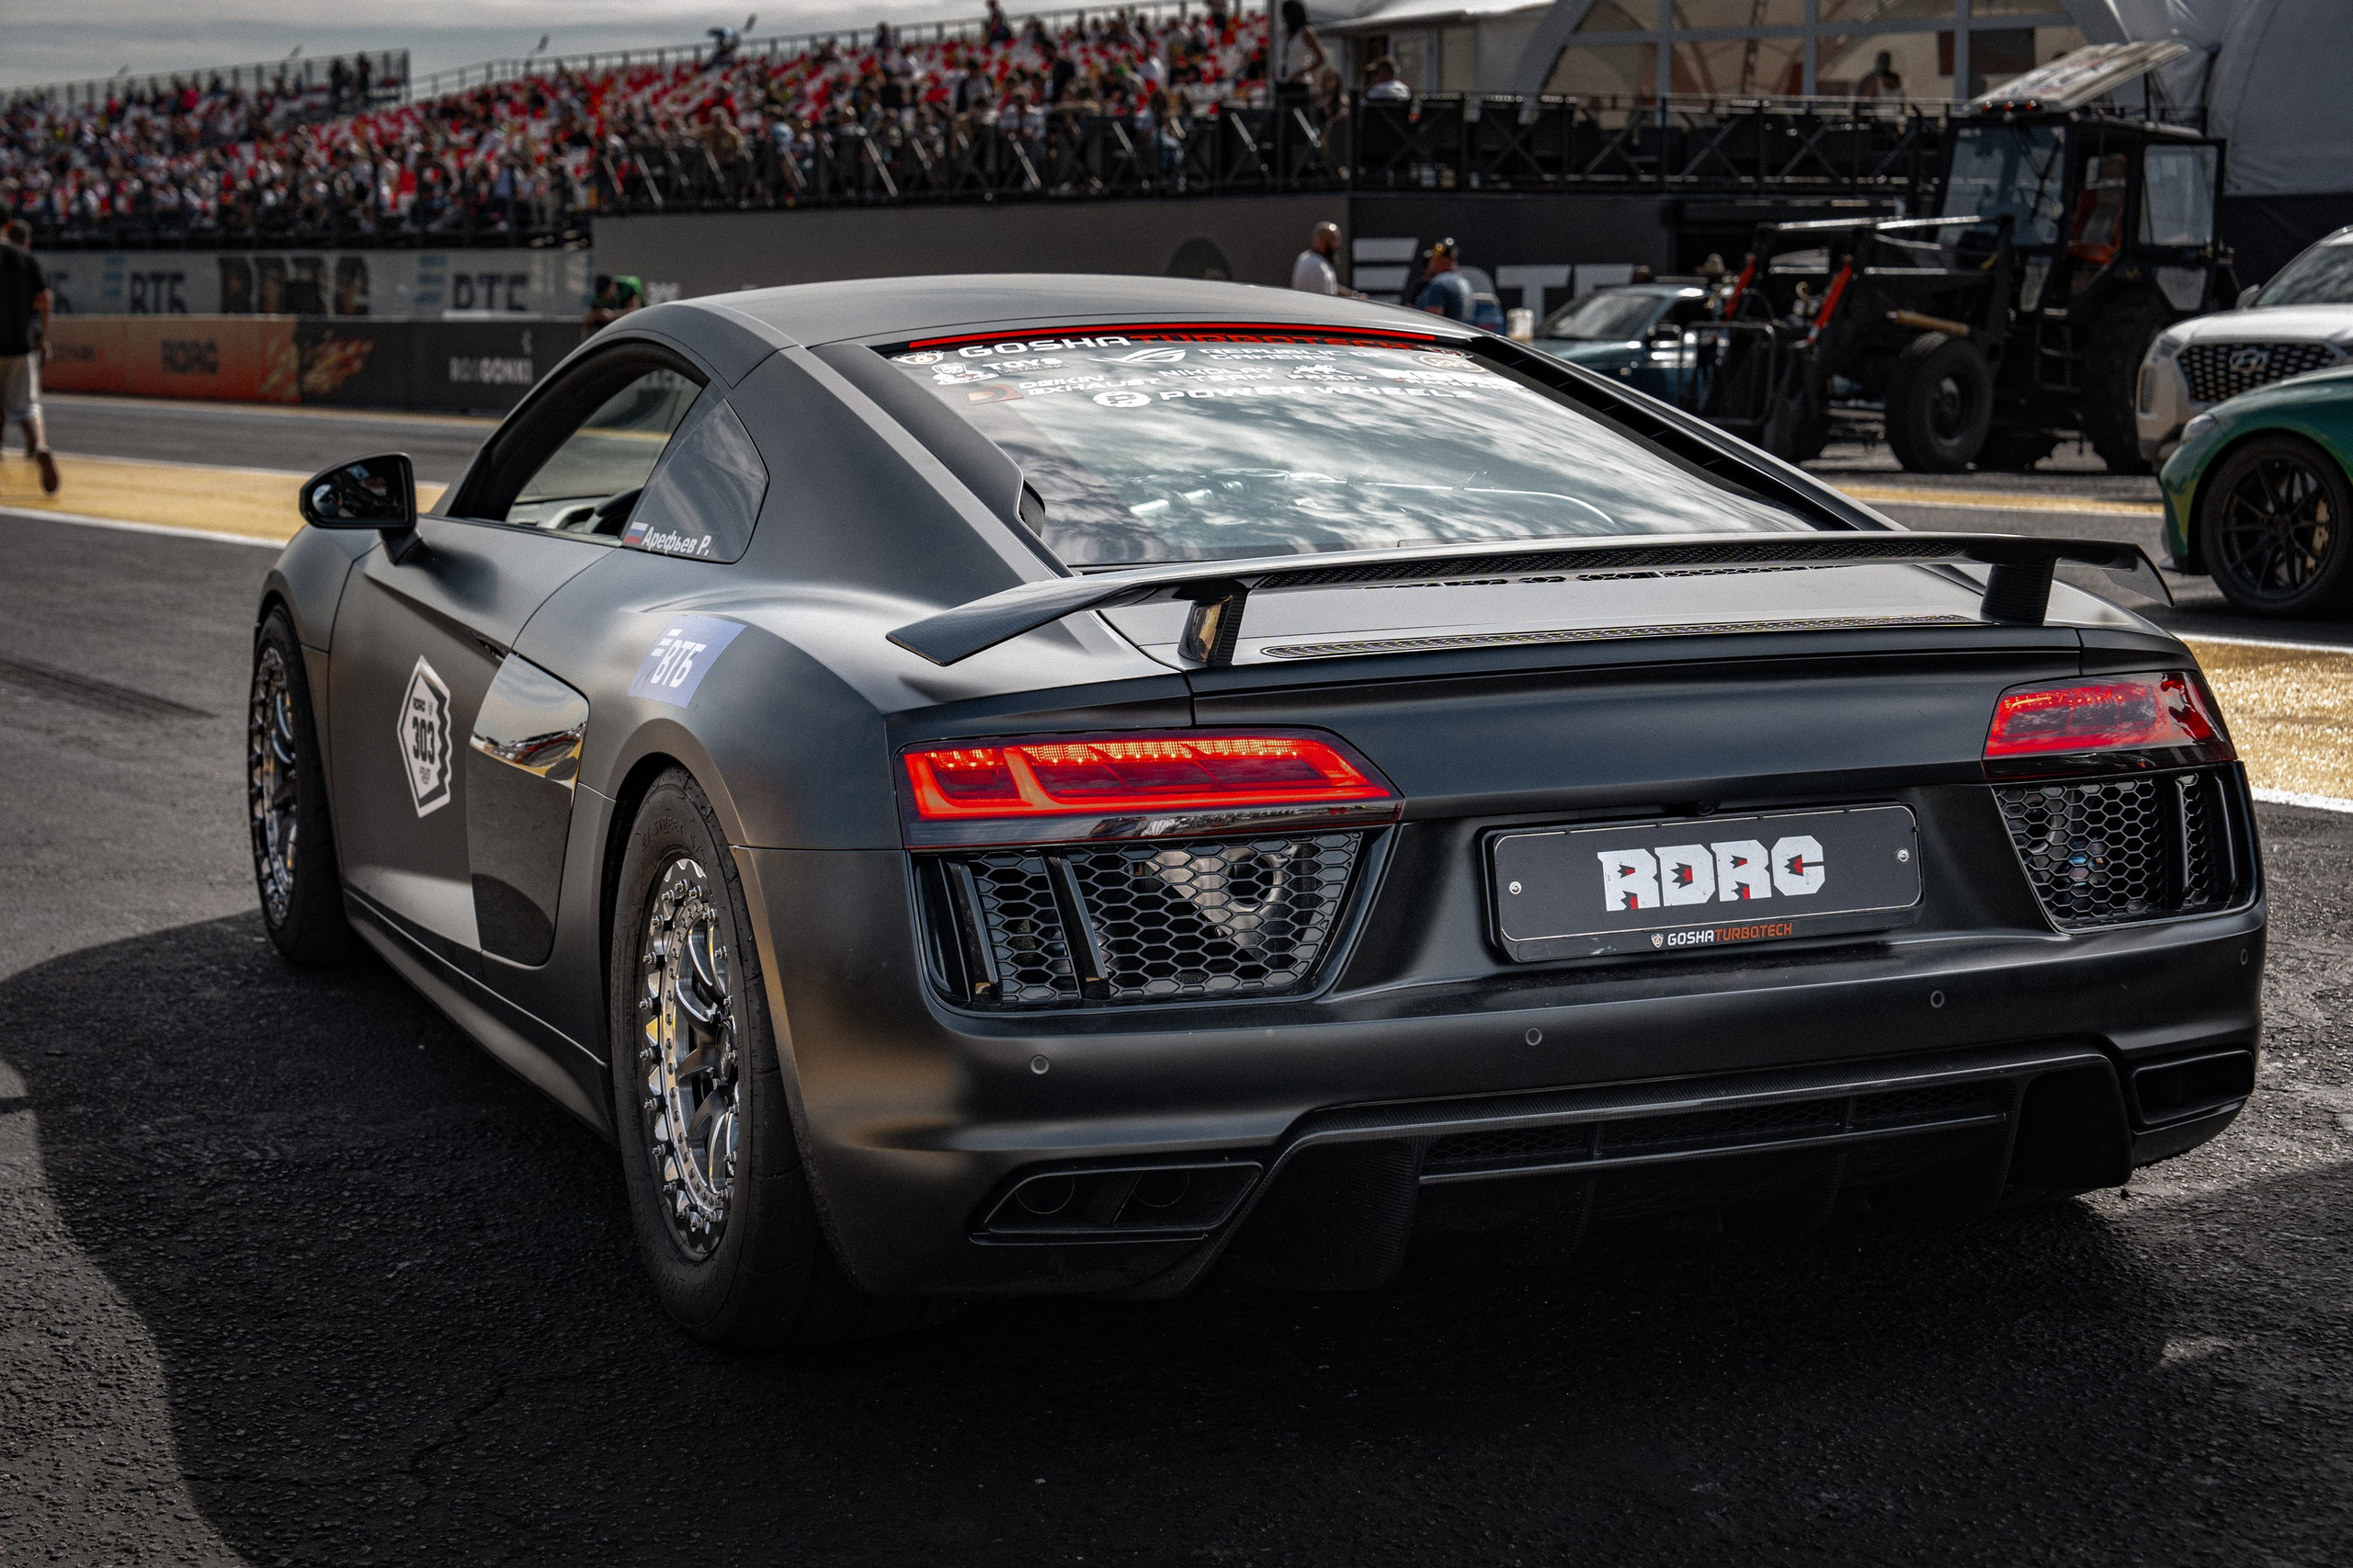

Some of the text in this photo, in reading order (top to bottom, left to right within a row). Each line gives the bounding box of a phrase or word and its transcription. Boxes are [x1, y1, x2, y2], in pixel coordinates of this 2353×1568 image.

[1199, 348, 1347, 357] REPUBLIC
[982, 358, 1063, 371] TOYS
[1157, 368, 1274, 377] NIKOLAY
[1188, 374, 1272, 382] TEAM
[1158, 386, 1308, 401] POWER
[1313, 385, 1477, 399] WHEELS
[641, 526, 699, 557] Арефьев
[651, 639, 708, 687] ВТБ
[412, 715, 436, 766] 303
[1597, 835, 1825, 912] RDRC
[1667, 923, 1792, 946] GOSHATURBOTECH
